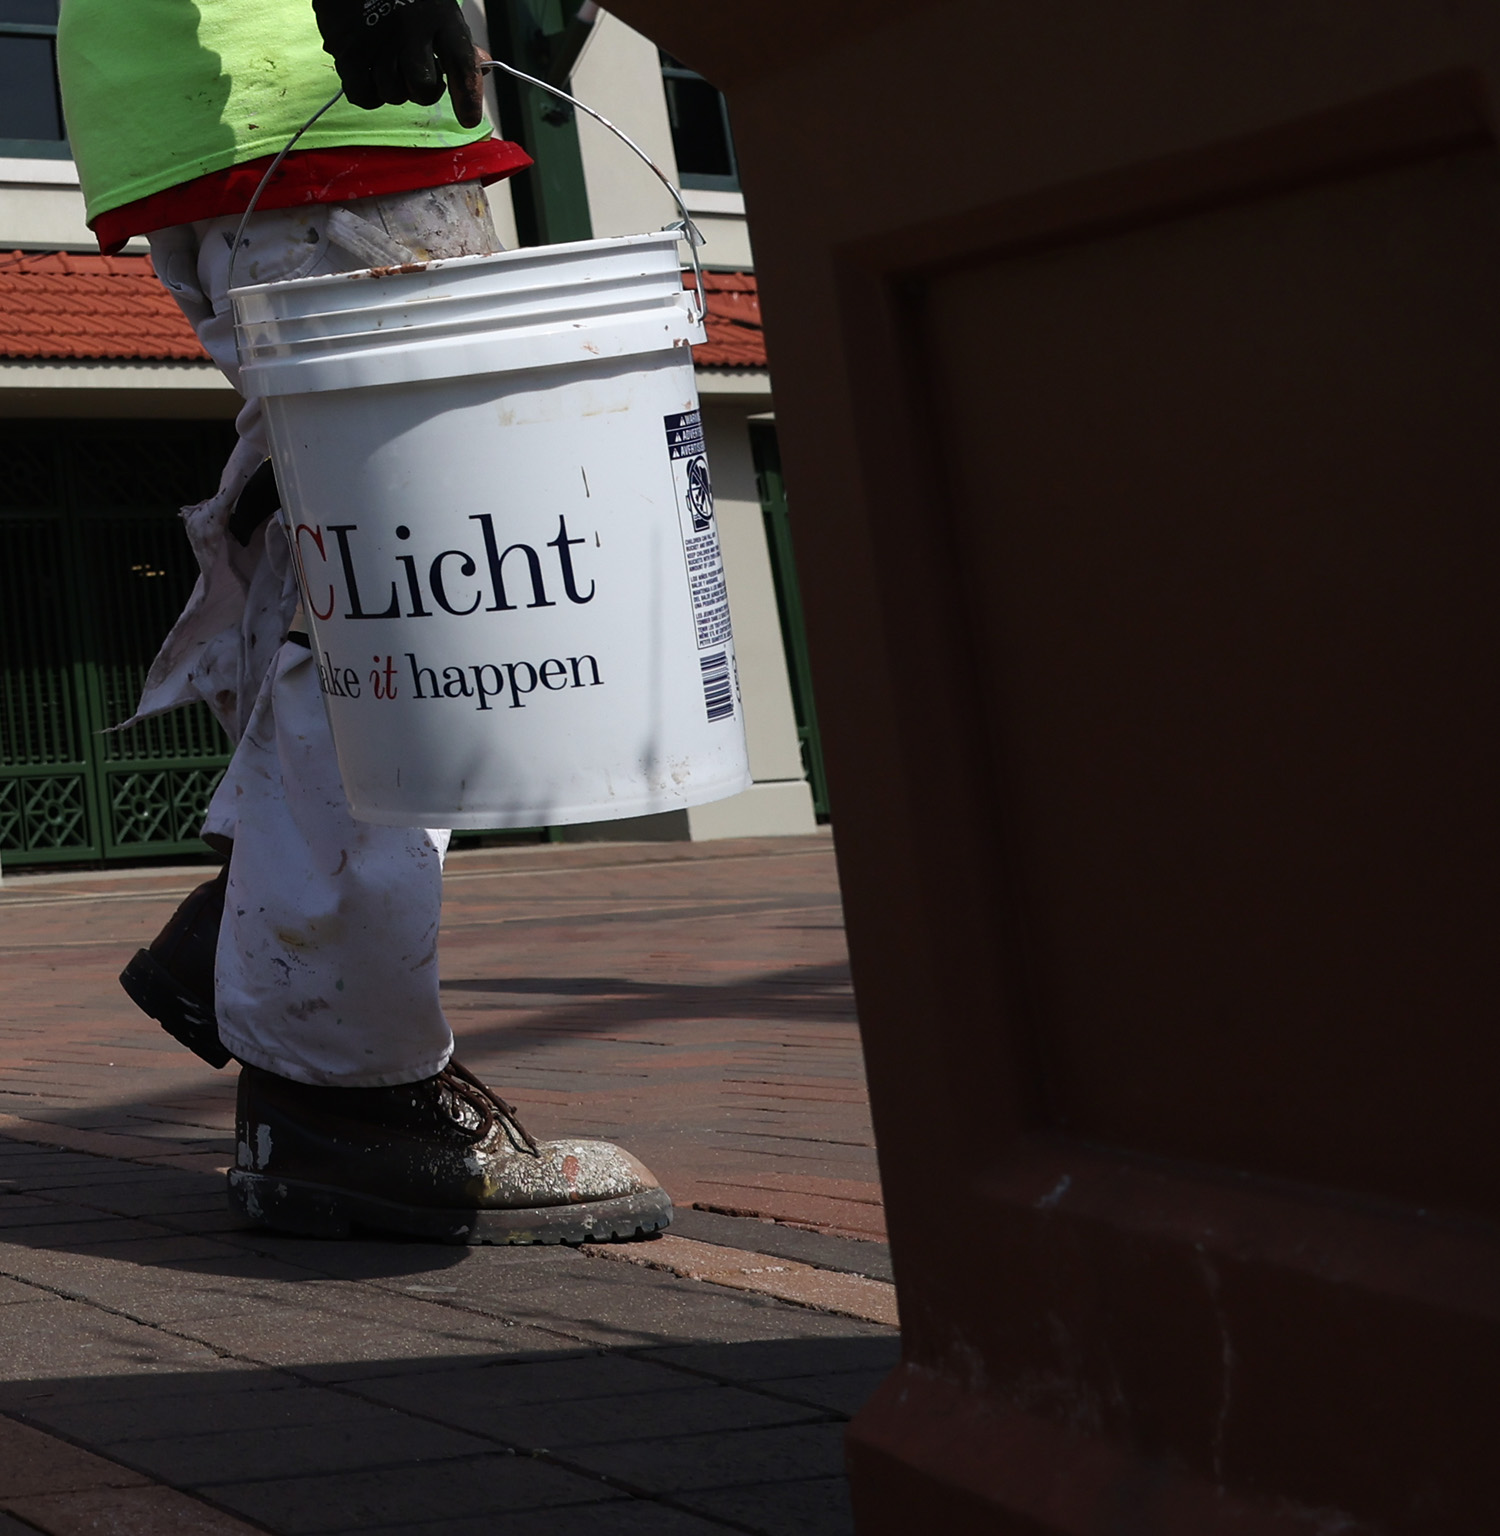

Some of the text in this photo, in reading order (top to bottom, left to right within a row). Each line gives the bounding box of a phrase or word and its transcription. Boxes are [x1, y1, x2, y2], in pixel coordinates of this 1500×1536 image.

[290, 513, 597, 621] CLicht
[318, 651, 604, 712] ake it happen
